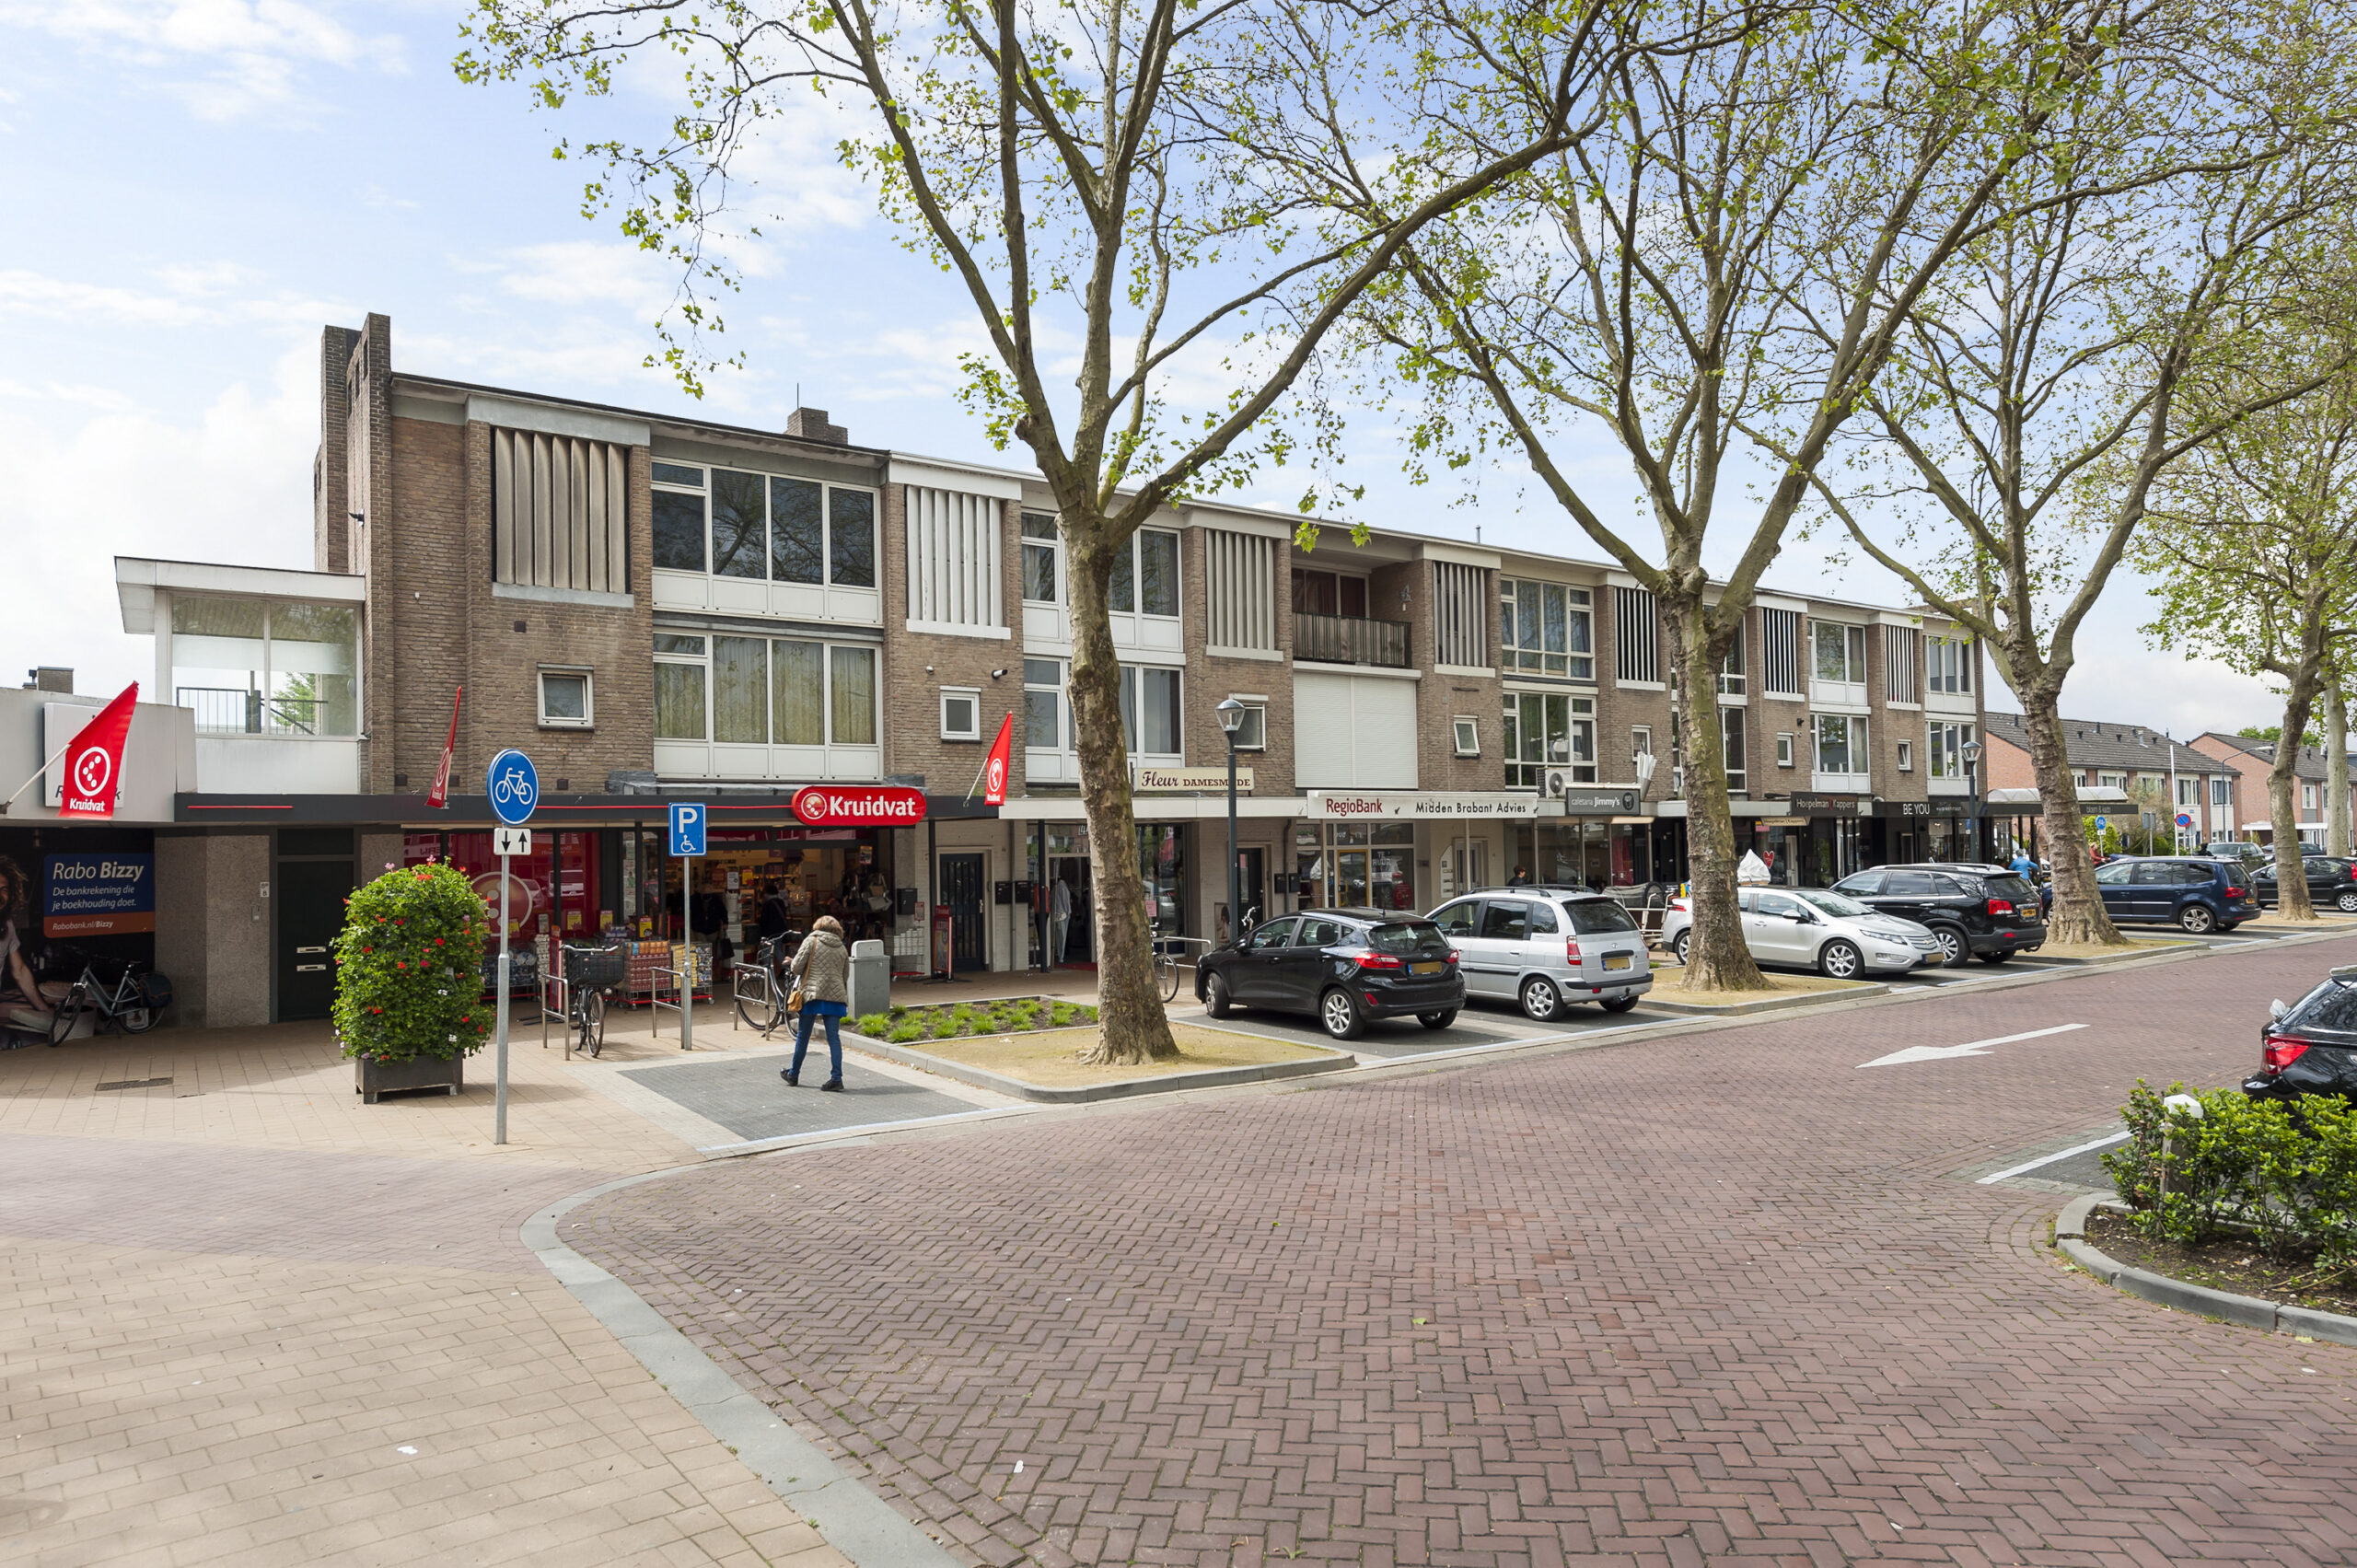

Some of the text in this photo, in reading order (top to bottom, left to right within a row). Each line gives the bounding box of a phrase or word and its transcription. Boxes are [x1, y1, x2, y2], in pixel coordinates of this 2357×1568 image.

[1142, 771, 1250, 787] Fleur DAMESMDE
[69, 797, 105, 812] Kruidvat
[830, 796, 916, 817] Kruidvat
[1326, 798, 1383, 818] RegioBank
[1415, 801, 1527, 814] Midden Brabant Advies
[1594, 796, 1620, 807] Jimmy's
[1832, 798, 1855, 811] Kappers
[1902, 803, 1931, 815] BE YOU
[679, 807, 698, 833] P
[52, 862, 145, 883] Rabo Bizzy
[52, 884, 135, 897] De bankrekening die
[52, 898, 137, 912] je boekhouding doet.
[52, 921, 113, 931] Rabobank.nl/Bizzy
